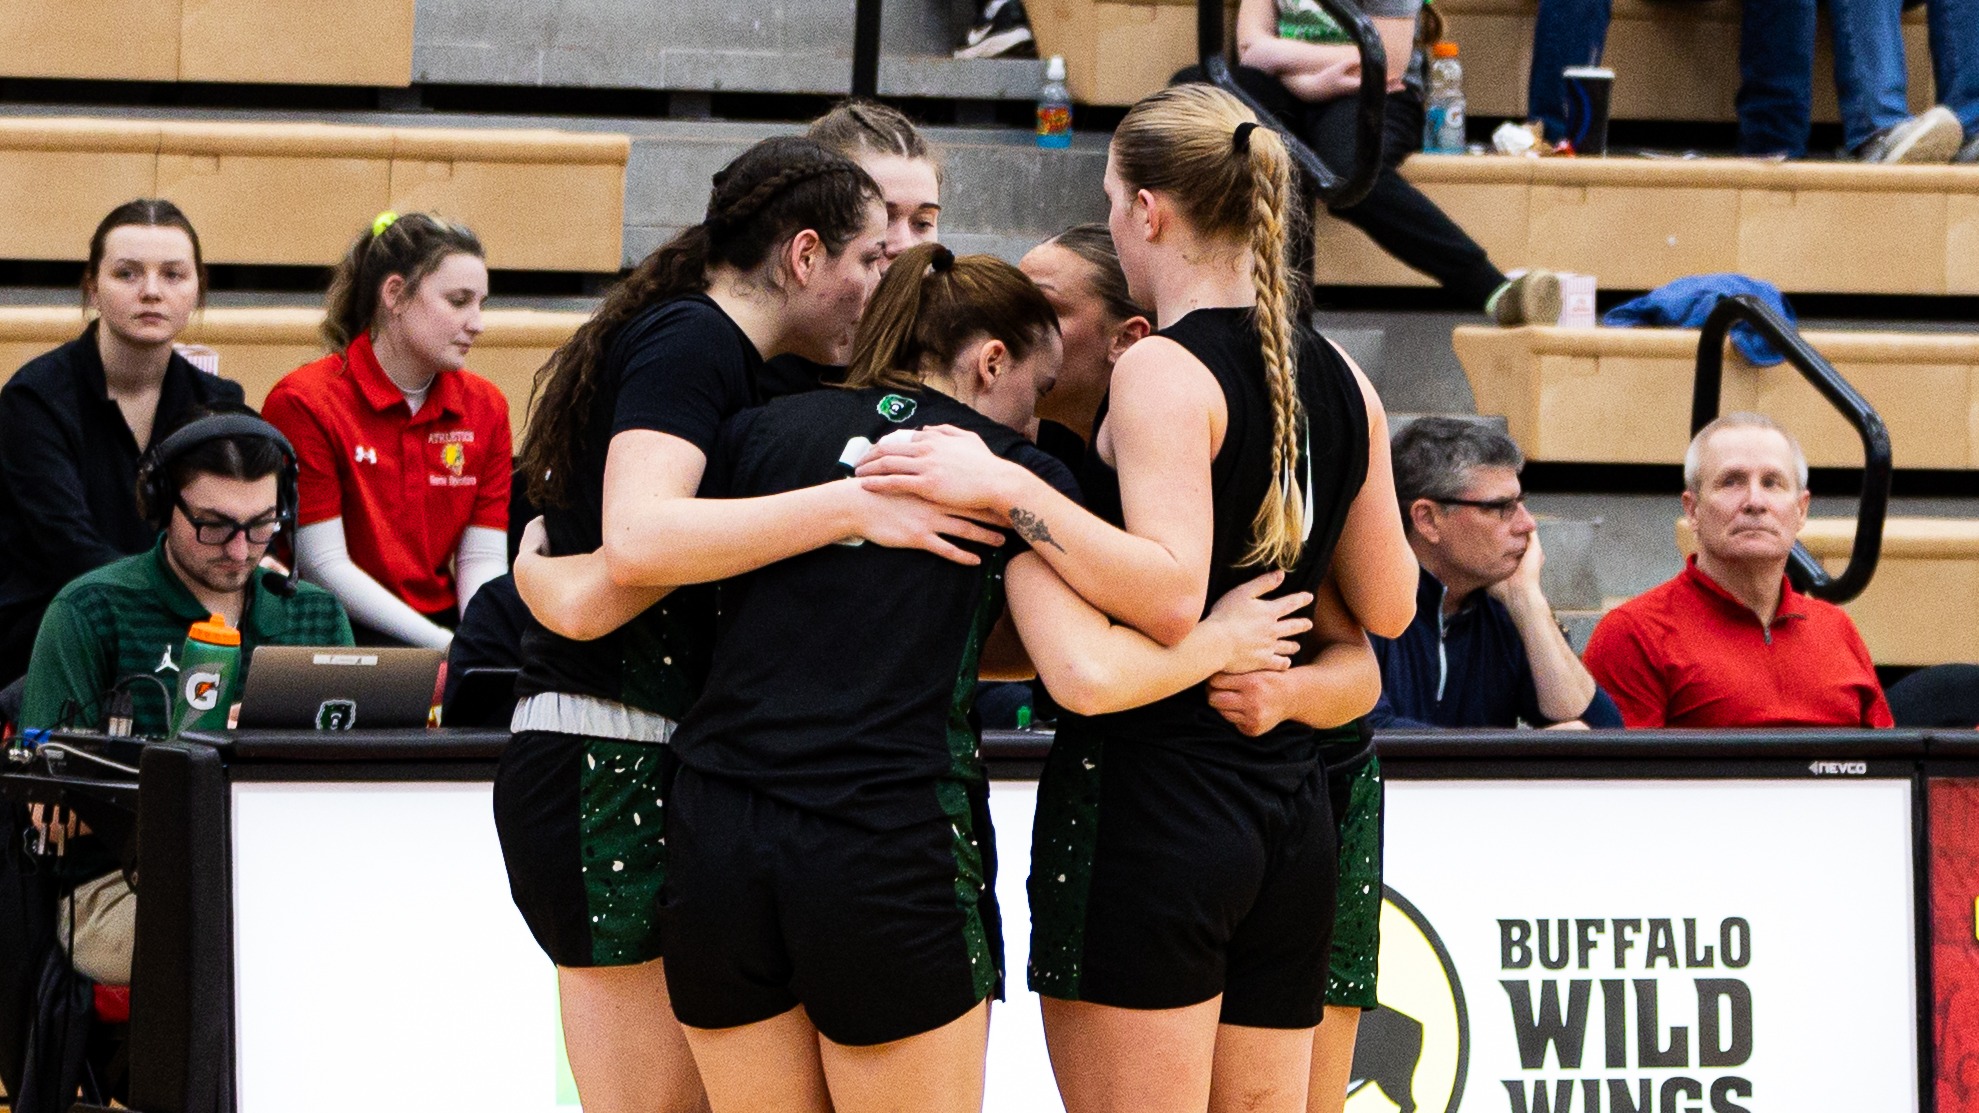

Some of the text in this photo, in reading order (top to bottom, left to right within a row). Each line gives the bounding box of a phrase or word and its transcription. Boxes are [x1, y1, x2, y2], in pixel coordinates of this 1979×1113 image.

[185, 672, 220, 710] G
[1496, 917, 1751, 970] BUFFALO
[1498, 978, 1753, 1069] WILD
